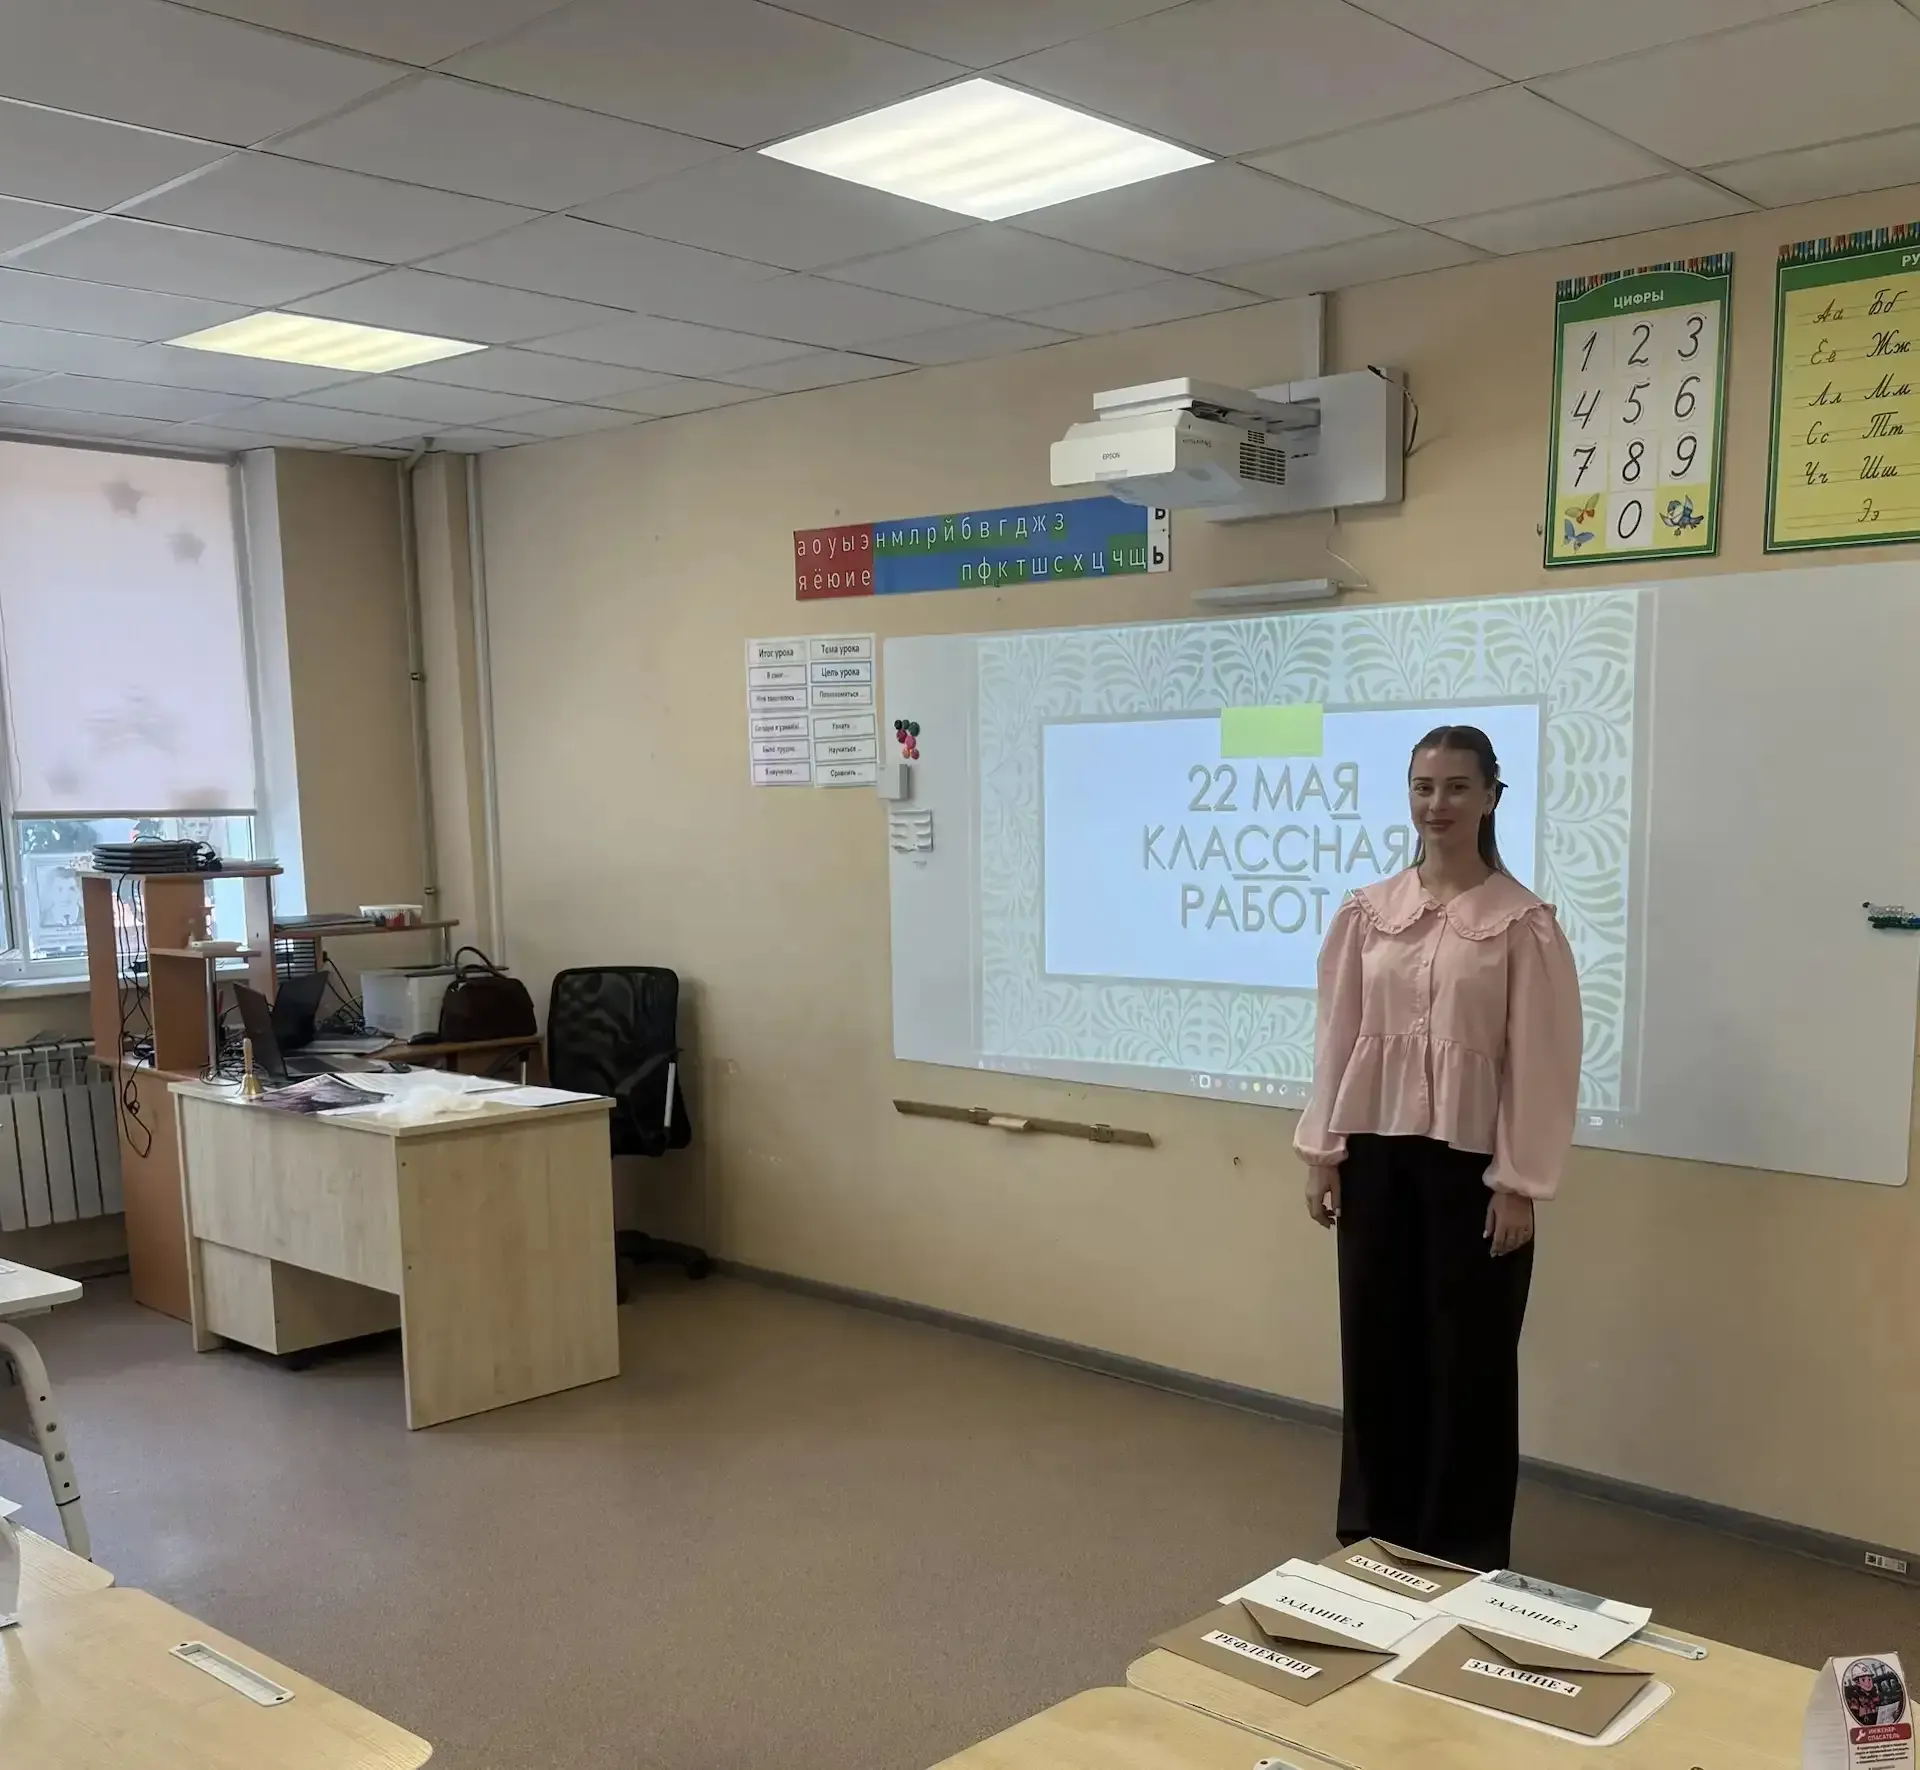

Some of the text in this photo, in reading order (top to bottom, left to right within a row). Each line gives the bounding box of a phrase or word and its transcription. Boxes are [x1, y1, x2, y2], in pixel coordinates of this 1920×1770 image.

[1613, 289, 1664, 309] ЦИФРЫ
[1813, 289, 1908, 324] Аа Бб
[1581, 315, 1705, 372] 1 2 3
[1866, 332, 1911, 358] Жж
[1572, 376, 1701, 430] 4 5 6
[1808, 373, 1911, 407] Лл Мм
[1807, 411, 1904, 445] Сс Тт
[1102, 452, 1120, 460] EPSON
[1573, 435, 1697, 487] 7 8 9
[1805, 455, 1898, 485] Чч Шш
[1617, 500, 1643, 539] 0
[1858, 498, 1880, 523] Ээ
[758, 648, 794, 659] Итог урока
[821, 644, 860, 656] Тема урока
[821, 667, 860, 679] Цель урока
[1187, 762, 1359, 812] 22 МАЯ
[1143, 824, 1410, 874] КЛАССНАЯ
[1351, 1557, 1424, 1586] ЗАДАНИЕ
[1276, 1595, 1352, 1624] ЗАДАНИЕ
[1485, 1597, 1566, 1627] ЗАДАНИЕ
[1214, 1633, 1312, 1673] РЕФЛЕКСИЯ
[1468, 1660, 1561, 1689] ЗАДАНИЕ
